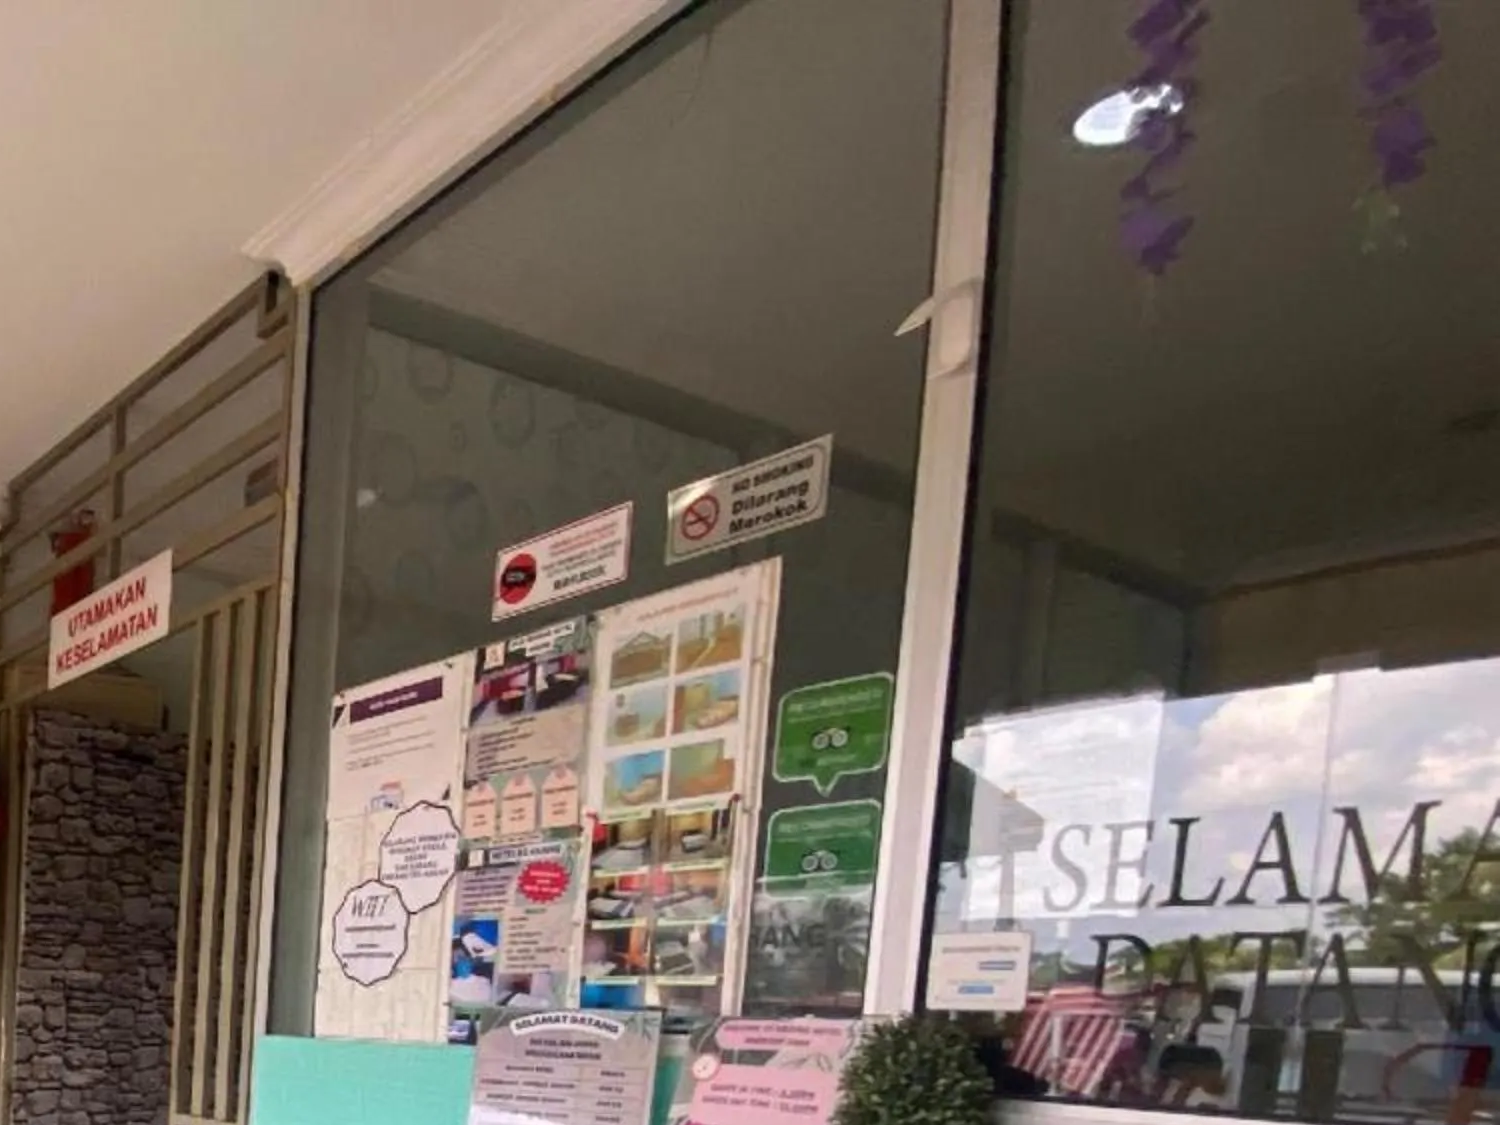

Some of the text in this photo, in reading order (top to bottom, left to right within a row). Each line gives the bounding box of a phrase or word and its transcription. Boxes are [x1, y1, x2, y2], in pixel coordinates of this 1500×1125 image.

[731, 480, 809, 515] Dilarang
[67, 575, 147, 637] UTAMAKAN
[55, 603, 158, 674] KESELAMATAN
